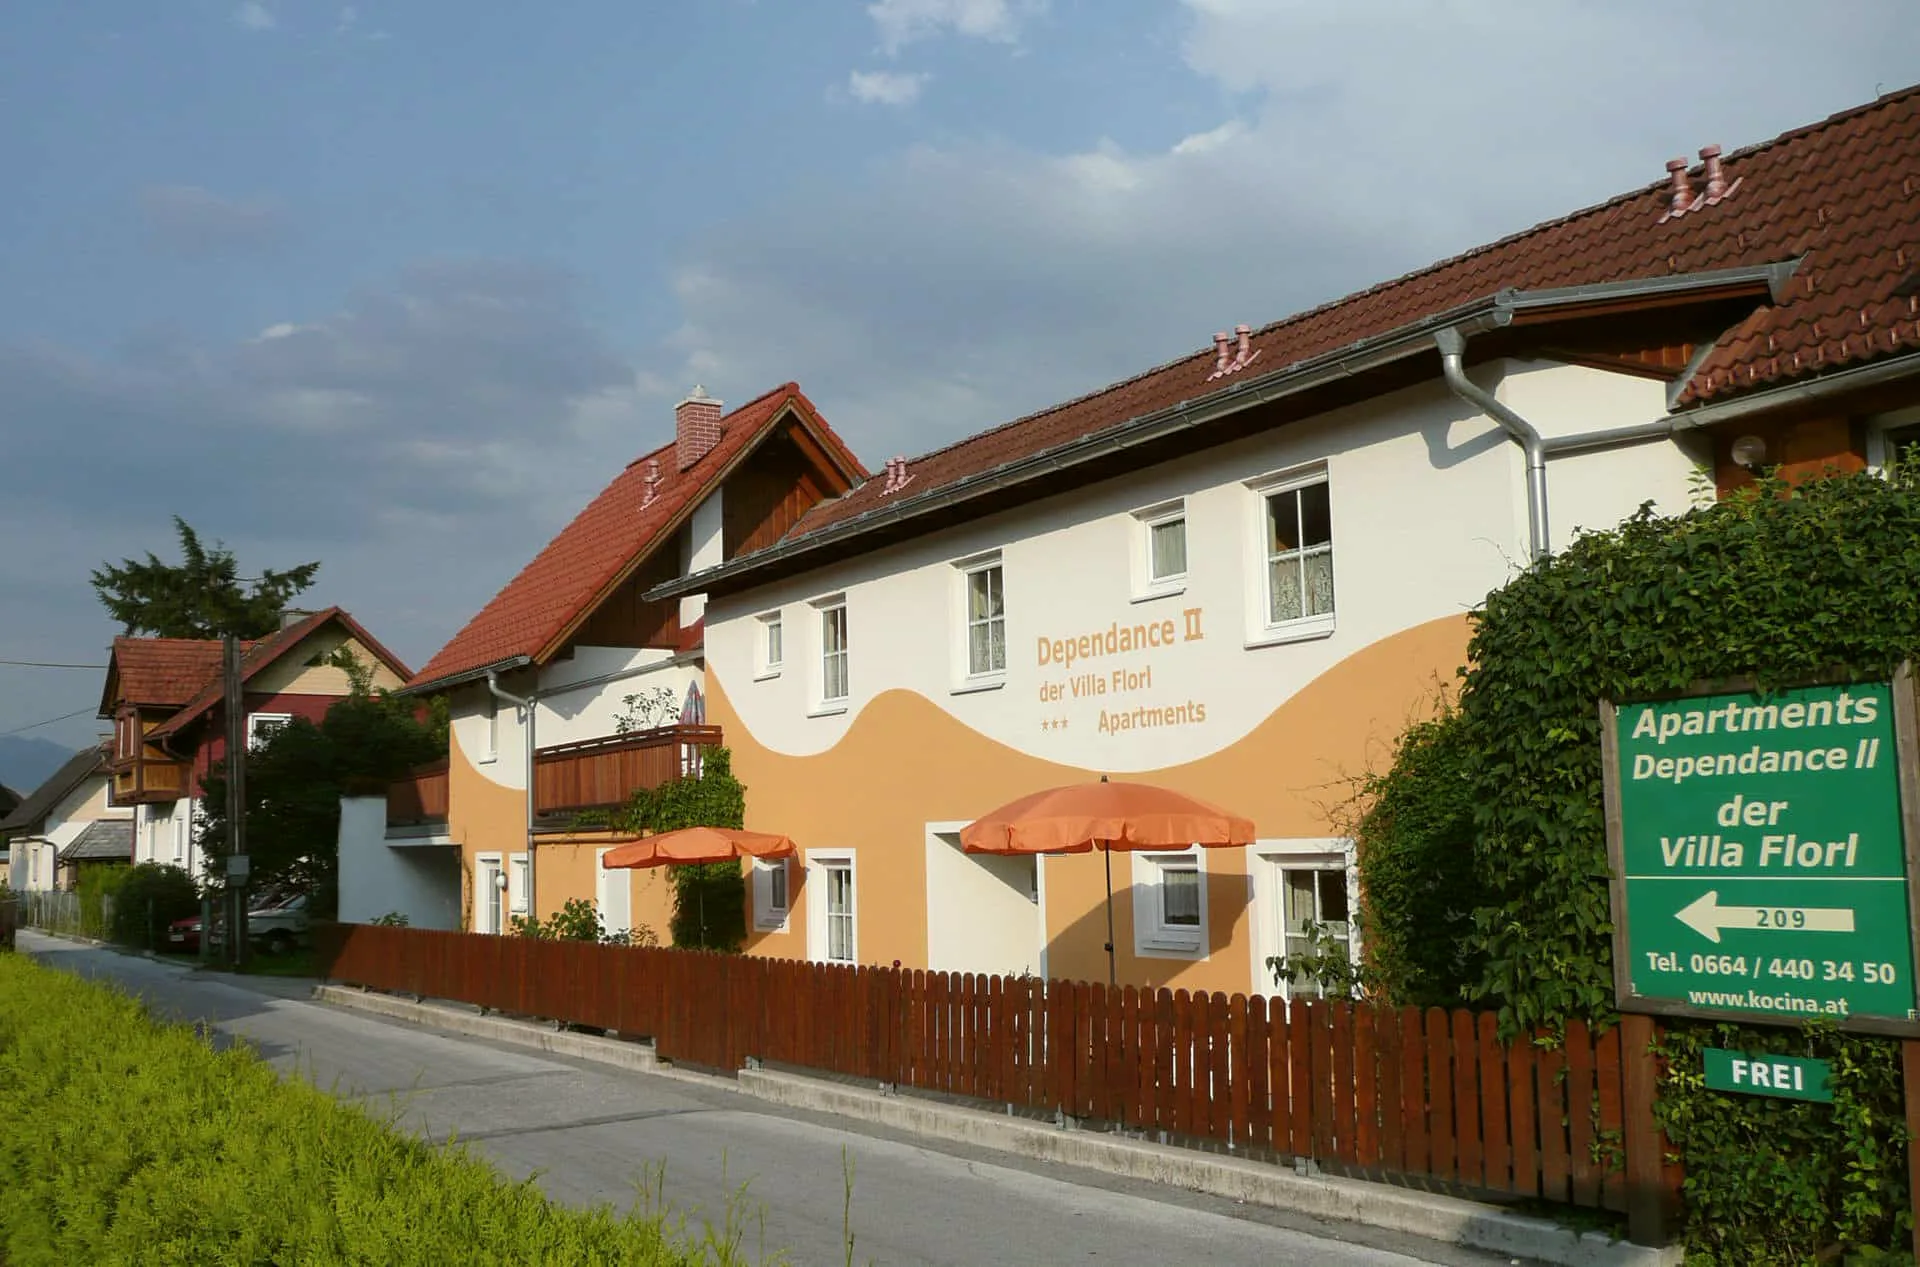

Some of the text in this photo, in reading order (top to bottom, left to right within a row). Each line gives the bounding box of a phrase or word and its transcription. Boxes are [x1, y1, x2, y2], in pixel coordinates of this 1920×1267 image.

[1037, 607, 1205, 669] Dependance II
[1039, 681, 1065, 702] der
[1069, 672, 1106, 697] Villa
[1098, 700, 1206, 736] Apartments
[1631, 692, 1879, 745] Apartments
[1632, 745, 1848, 784] Dependance
[1717, 794, 1789, 827] der
[1660, 835, 1744, 868] Villa
[1756, 909, 1806, 929] 209
[1646, 951, 1897, 985] Tel. 0664 / 440 34 50
[1688, 989, 1849, 1015] www.kocina.at
[1731, 1059, 1804, 1091] FREI
